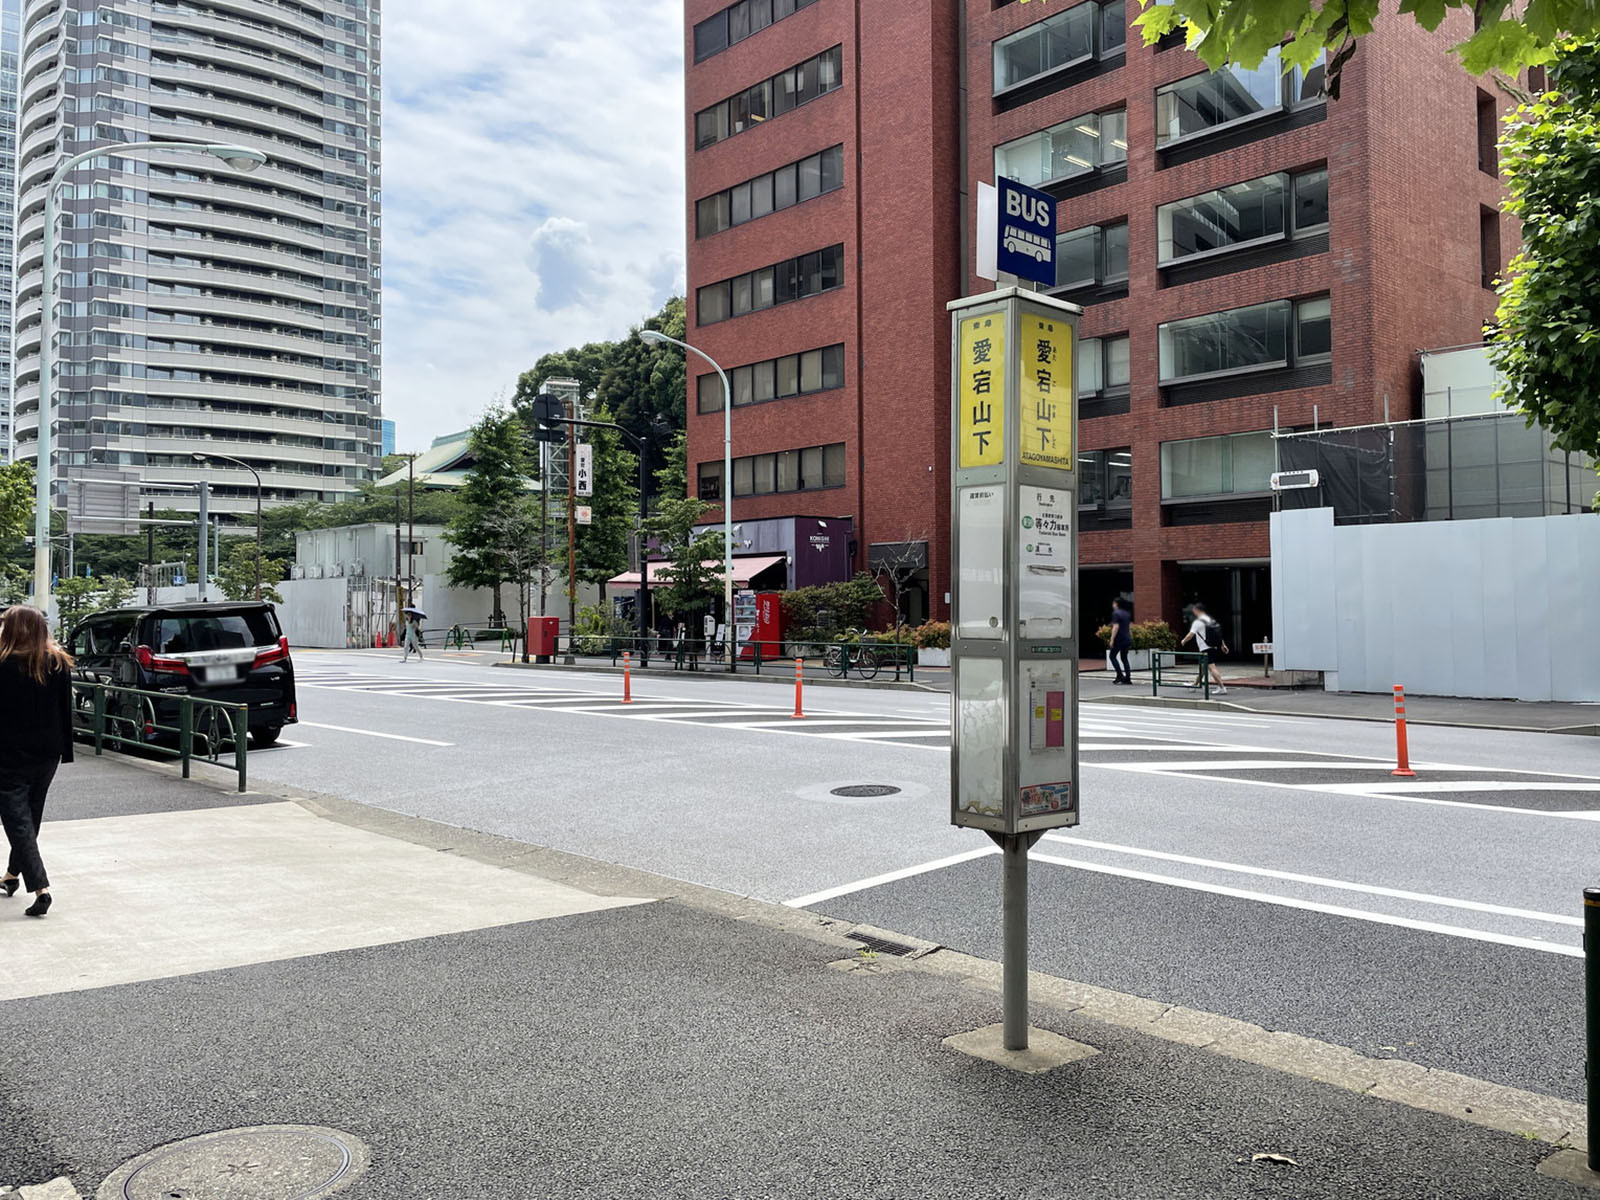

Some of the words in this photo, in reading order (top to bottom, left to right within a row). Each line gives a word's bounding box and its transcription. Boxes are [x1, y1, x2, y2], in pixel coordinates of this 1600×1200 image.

[1005, 188, 1050, 228] BUS
[972, 338, 992, 456] 愛宕山下
[1036, 338, 1052, 452] 愛宕山下
[1022, 451, 1070, 466] ATAGOYAMASHITA
